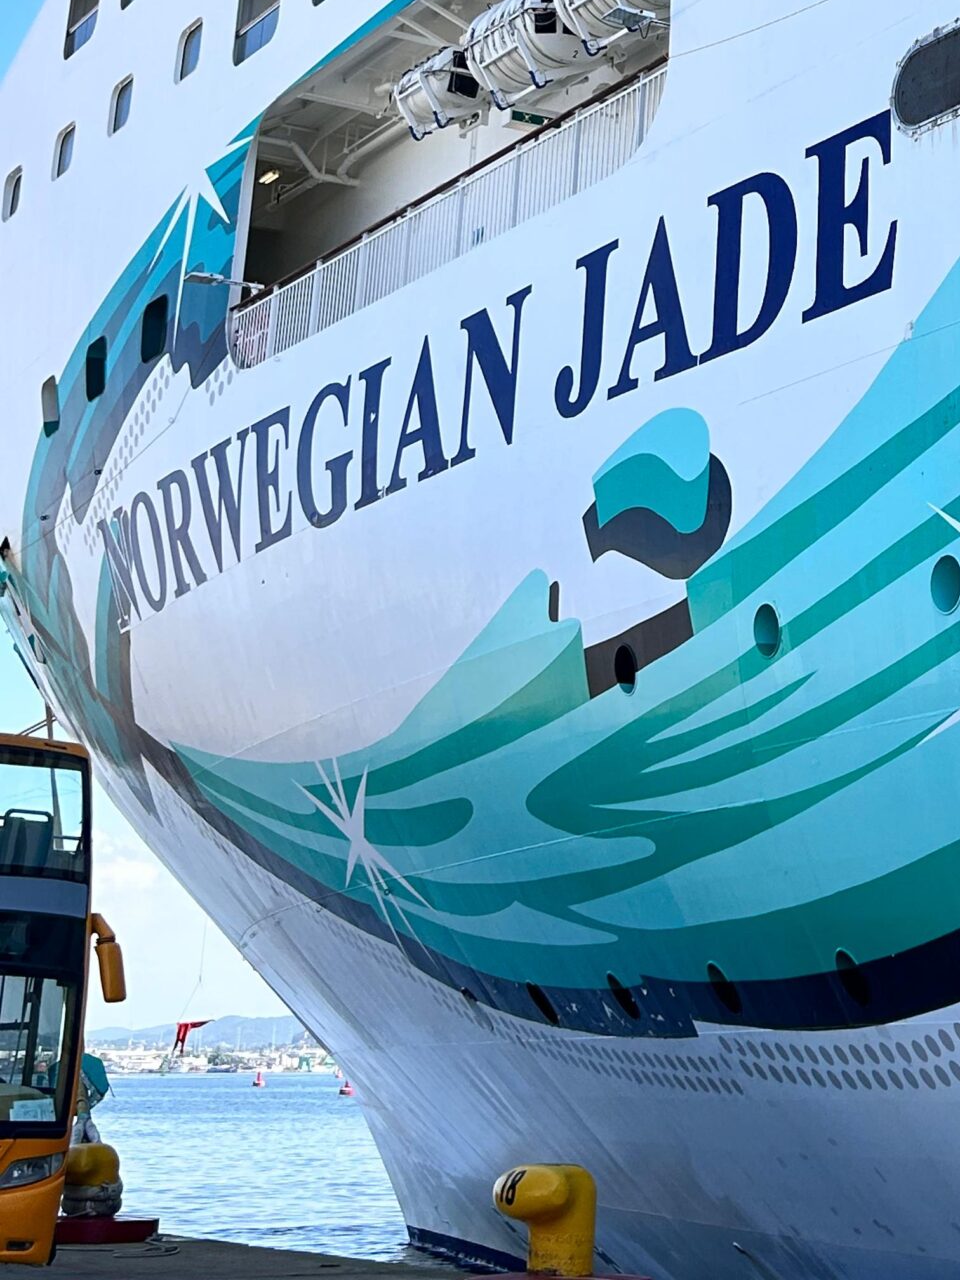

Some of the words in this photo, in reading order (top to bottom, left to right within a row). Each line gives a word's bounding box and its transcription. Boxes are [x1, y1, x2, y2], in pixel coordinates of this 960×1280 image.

[97, 284, 532, 631] NORWEGIAN
[554, 110, 898, 418] JADE
[500, 1169, 527, 1206] 18
